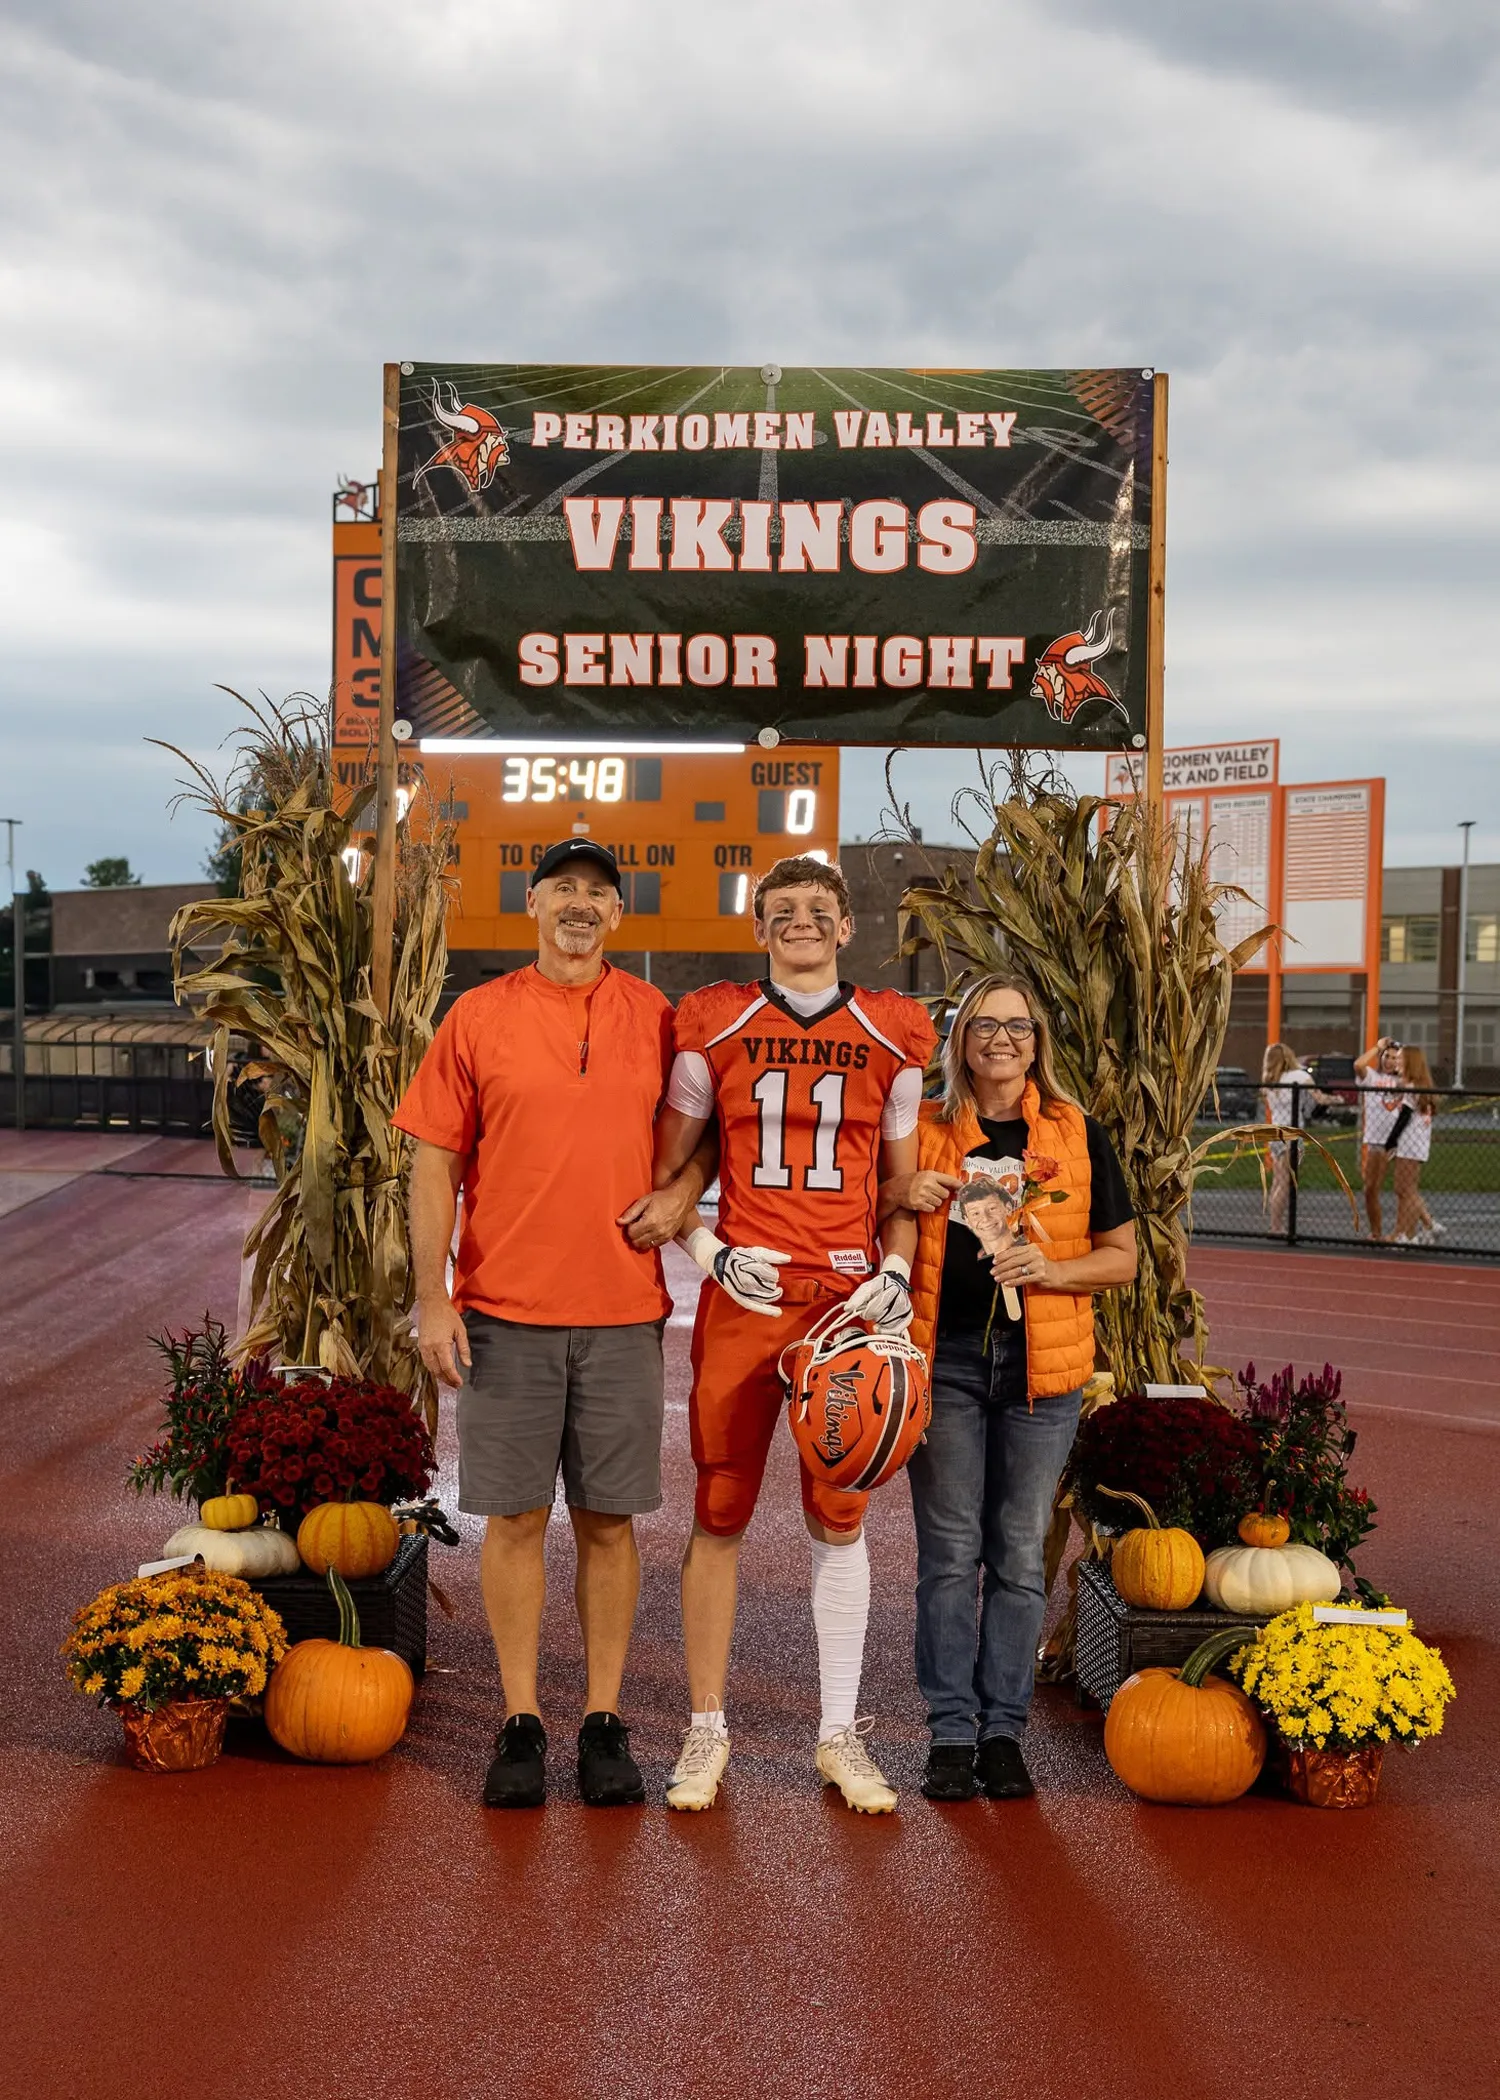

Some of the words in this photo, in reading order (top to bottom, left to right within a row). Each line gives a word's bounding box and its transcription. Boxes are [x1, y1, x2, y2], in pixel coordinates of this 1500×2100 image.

[531, 411, 815, 451] PERKIOMEN
[832, 411, 1017, 449] VALLEY
[564, 497, 978, 573] VIKINGS
[518, 632, 778, 688] SENIOR
[803, 635, 1026, 689] NIGHT
[502, 757, 625, 802] 35:48
[751, 762, 823, 786] GUEST
[1133, 753, 1211, 772] PIOMEN
[1215, 747, 1270, 764] VALLEY
[1134, 771, 1182, 788] TCK
[1186, 766, 1220, 784] AND
[1224, 764, 1269, 781] FIELD
[786, 788, 816, 835] 0
[500, 845, 523, 866] TO
[647, 844, 676, 866] ON
[714, 844, 752, 868] QTR
[735, 873, 748, 915] 1
[742, 1037, 871, 1069] VIKINGS
[751, 1068, 847, 1192] 11
[819, 1369, 865, 1459] Vikings
